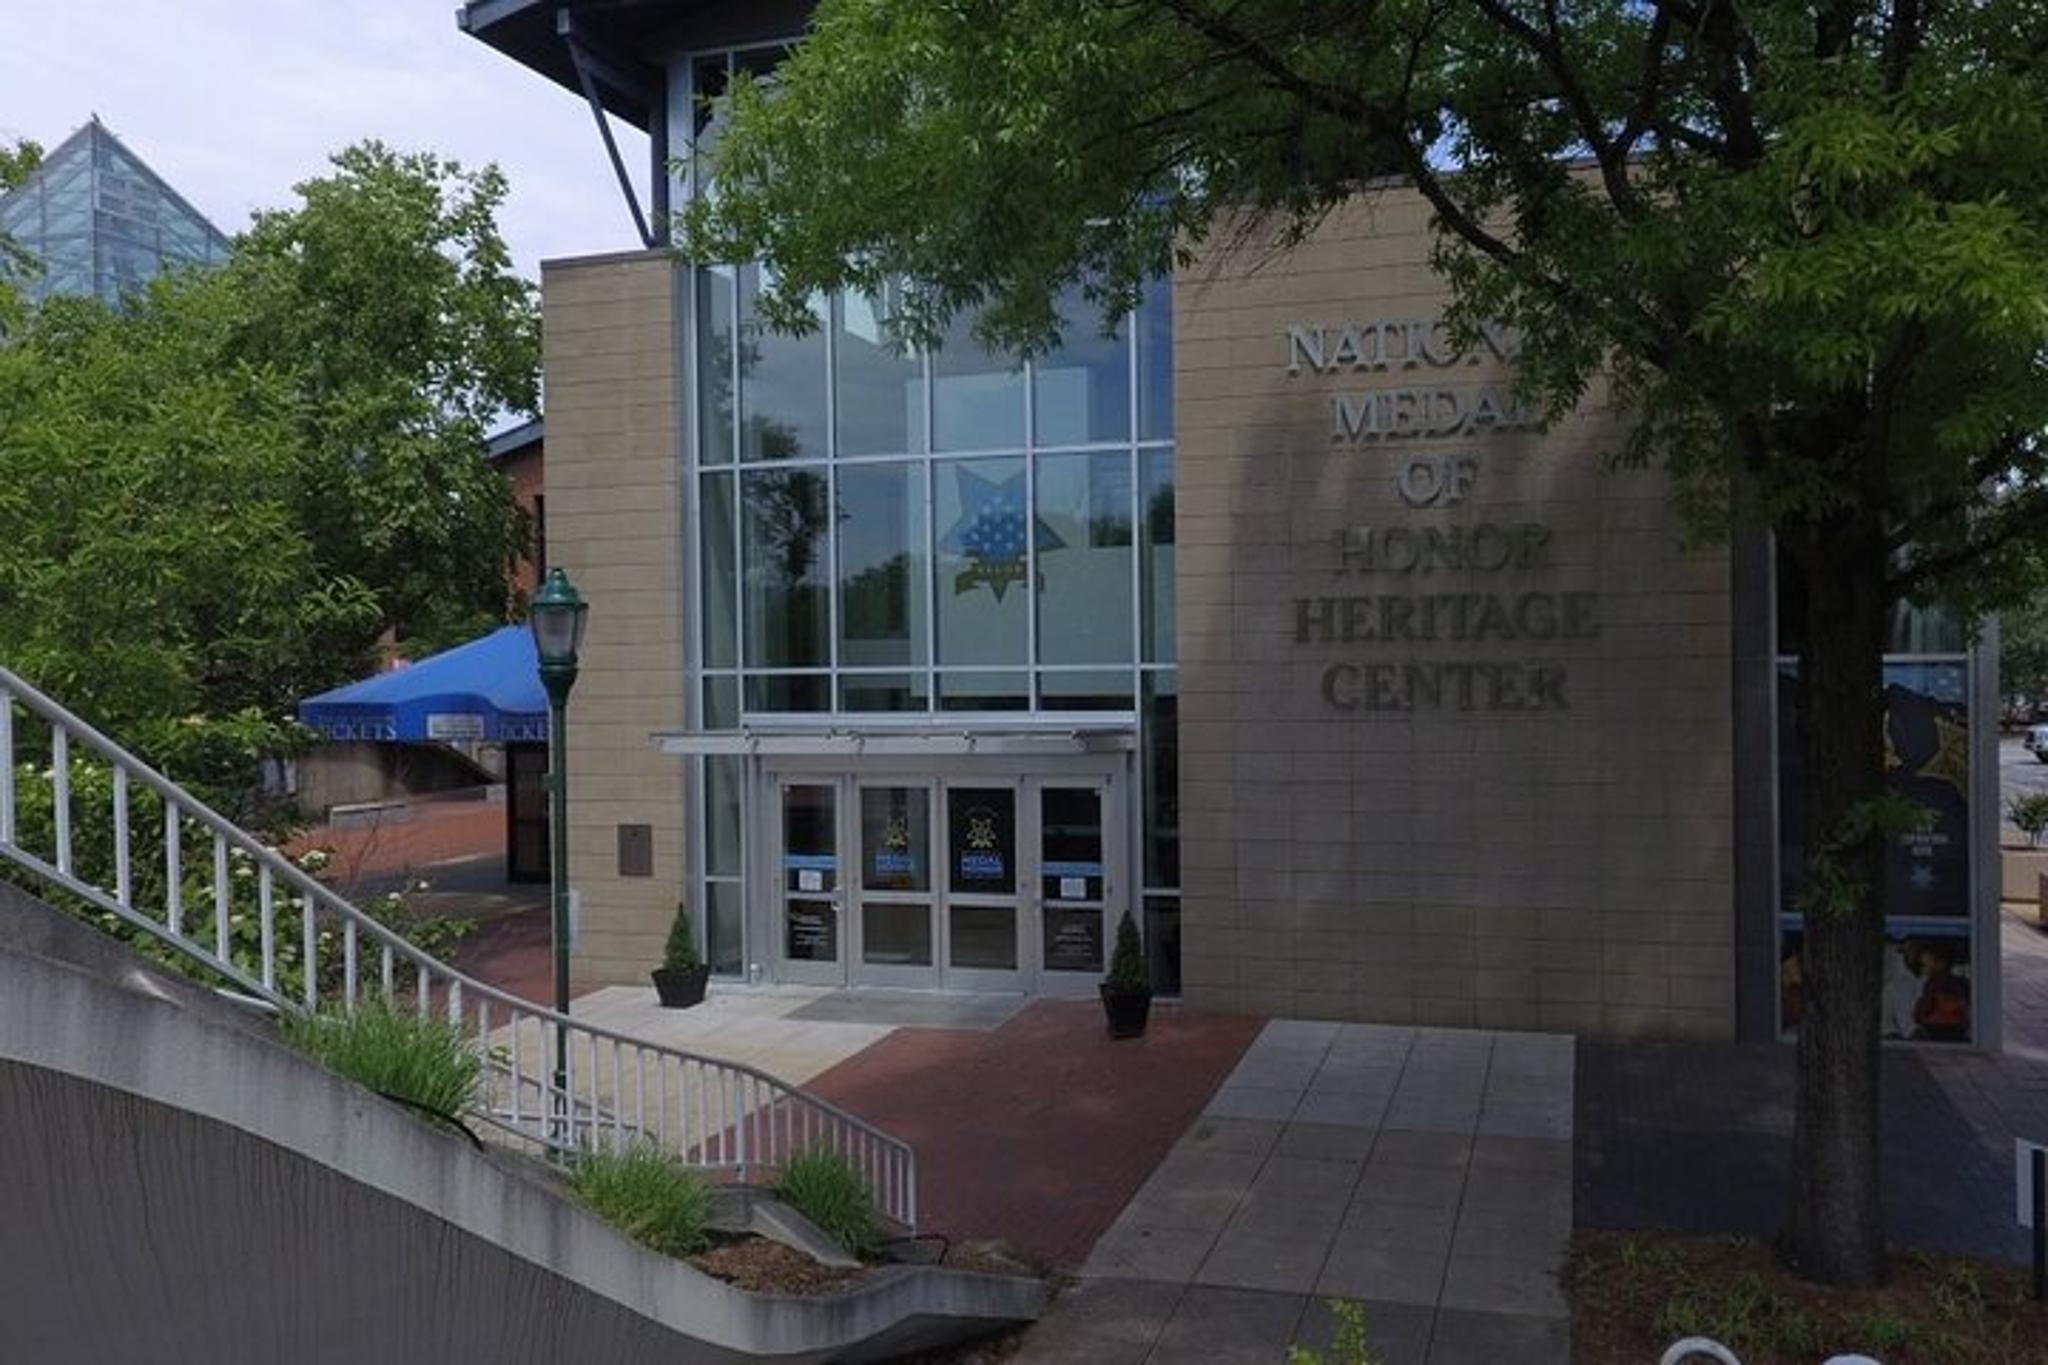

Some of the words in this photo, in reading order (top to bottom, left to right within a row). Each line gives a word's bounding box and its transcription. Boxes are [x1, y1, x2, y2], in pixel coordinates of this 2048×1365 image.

[1286, 320, 1525, 374] NATION
[1396, 456, 1478, 508] OF
[1333, 523, 1552, 574] HONOR
[1292, 592, 1600, 643] HERITAGE
[1320, 661, 1570, 711] CENTER
